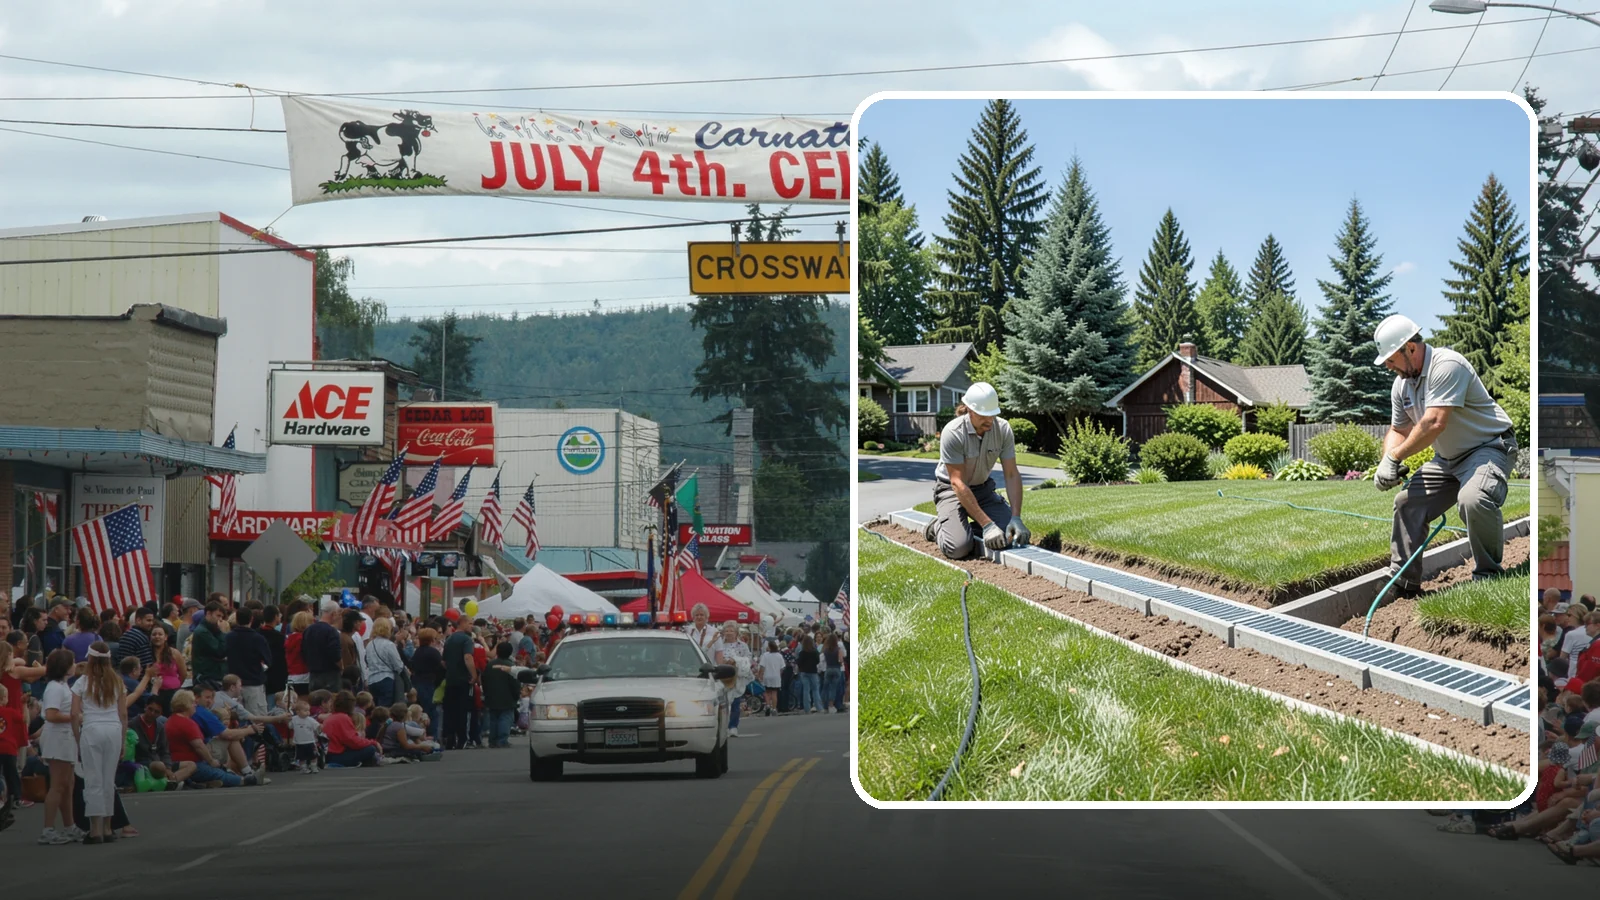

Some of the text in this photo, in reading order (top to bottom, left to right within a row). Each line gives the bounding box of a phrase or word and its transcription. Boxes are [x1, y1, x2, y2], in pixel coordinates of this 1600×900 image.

[481, 141, 605, 193] JULY
[632, 150, 746, 198] 4th.
[697, 254, 850, 280] CROSSWA
[283, 380, 373, 420] ACE
[405, 409, 452, 421] CEDAR
[283, 421, 371, 436] Hardware
[83, 485, 155, 495] St. Vincent de Paul
[213, 516, 330, 535] HARDARE
[688, 526, 741, 535] CRNATION
[699, 535, 730, 543] GLASS
